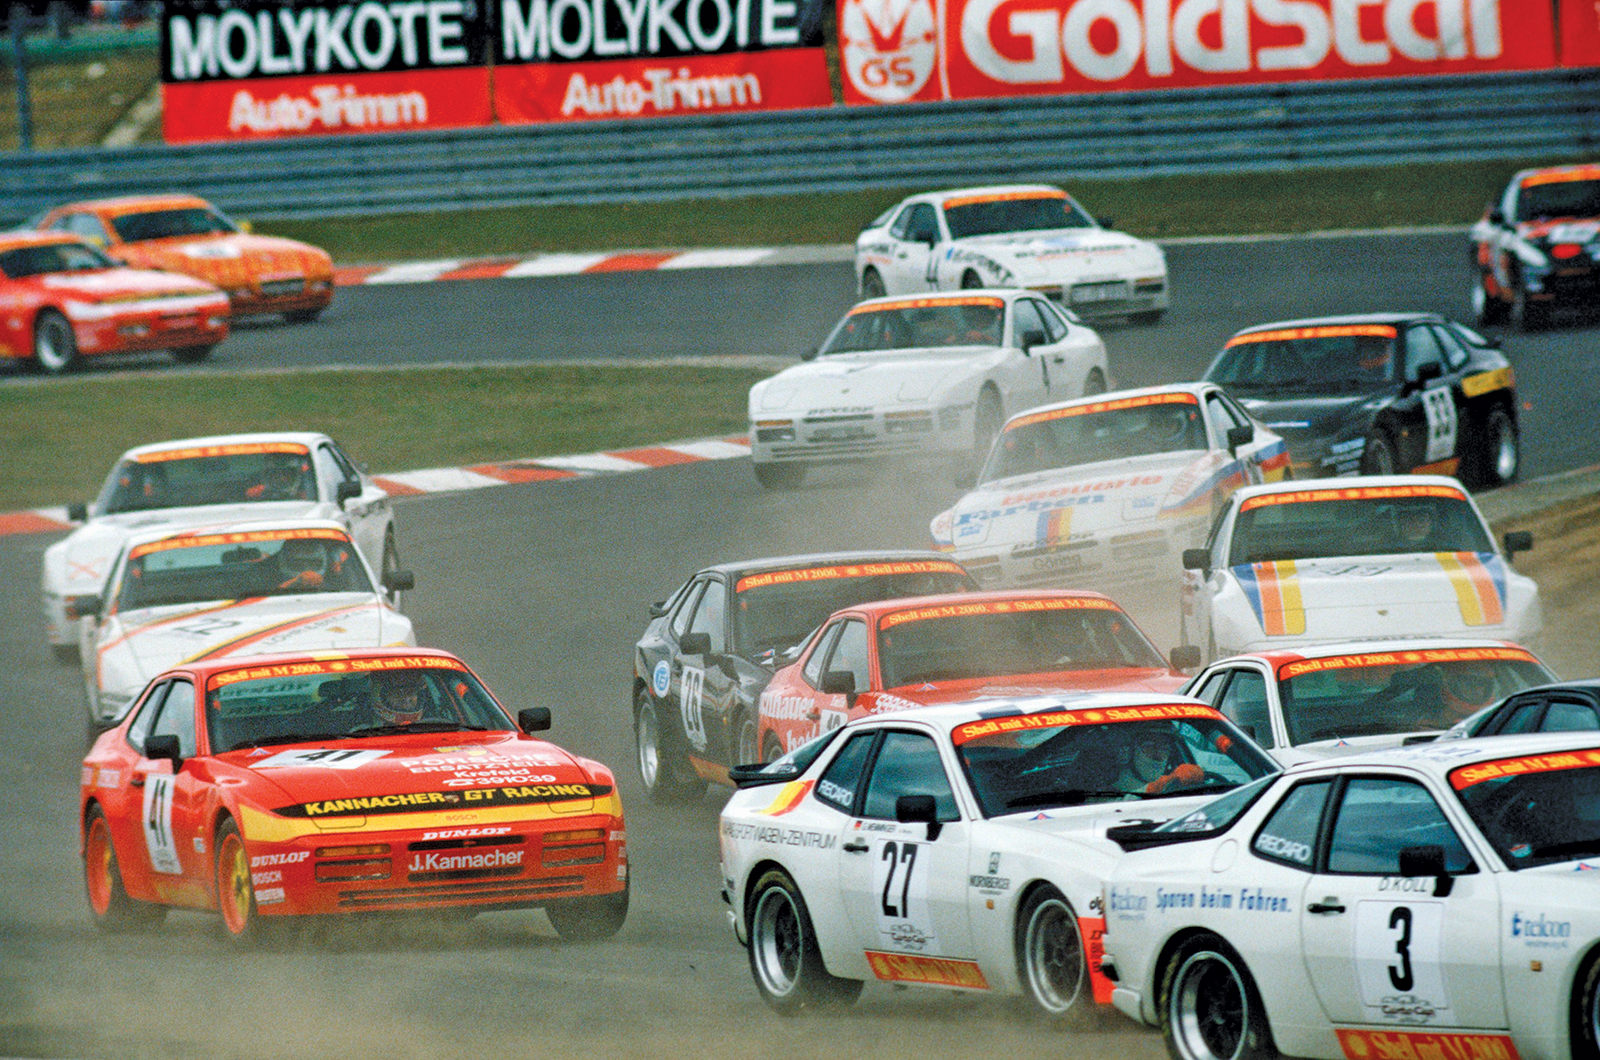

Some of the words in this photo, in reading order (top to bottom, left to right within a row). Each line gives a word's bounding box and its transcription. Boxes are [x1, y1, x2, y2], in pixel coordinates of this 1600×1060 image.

[170, 1, 468, 78] MOLYKOTE
[502, 0, 800, 59] MOLYKOTE
[861, 57, 915, 88] GS
[562, 68, 761, 116] Auto-Trimm
[229, 85, 427, 132] Auto-Trimm
[744, 574, 773, 588] Shell
[773, 571, 795, 583] mit
[795, 570, 811, 581] M
[864, 565, 893, 576] Shell
[893, 562, 913, 574] mit
[913, 561, 928, 573] M
[888, 610, 919, 626] Shell
[919, 608, 941, 621] mit
[941, 606, 959, 619] M
[1014, 600, 1043, 612] Shell
[1043, 599, 1065, 610] mit
[1065, 598, 1081, 609] M
[217, 668, 249, 687] Shell
[249, 666, 272, 679] mit
[272, 663, 293, 677] M
[351, 660, 381, 672] Shell
[381, 658, 403, 670] mit
[402, 657, 423, 669] M
[1288, 656, 1324, 674] Shell
[1323, 655, 1347, 668] mit
[1346, 653, 1366, 666] M
[1423, 650, 1458, 661] Shell
[962, 719, 1001, 738] Shell
[1000, 717, 1025, 731] mit
[1024, 715, 1045, 729] M
[1106, 708, 1143, 720] Shell
[1141, 707, 1165, 718] mit
[1163, 706, 1183, 716] M
[294, 749, 365, 762] 41
[400, 754, 556, 768] PORSCHE
[454, 768, 531, 778] Krefeld
[1460, 764, 1503, 783] Shell
[1501, 761, 1529, 774] mit
[1522, 758, 1549, 770] M
[305, 791, 444, 817] KANNACHER
[463, 789, 497, 802] GT
[502, 783, 592, 799] RACING
[445, 814, 480, 822] BOSCH
[422, 827, 512, 841] DUNLOP
[1255, 833, 1312, 862] RECARO
[251, 851, 310, 867] DUNLOP
[408, 849, 525, 872] J.Kannacher
[882, 841, 918, 918] 27
[1156, 887, 1195, 913] Sparen
[1201, 885, 1233, 908] beim
[1240, 887, 1292, 913] Fahren.
[1388, 906, 1413, 992] 3
